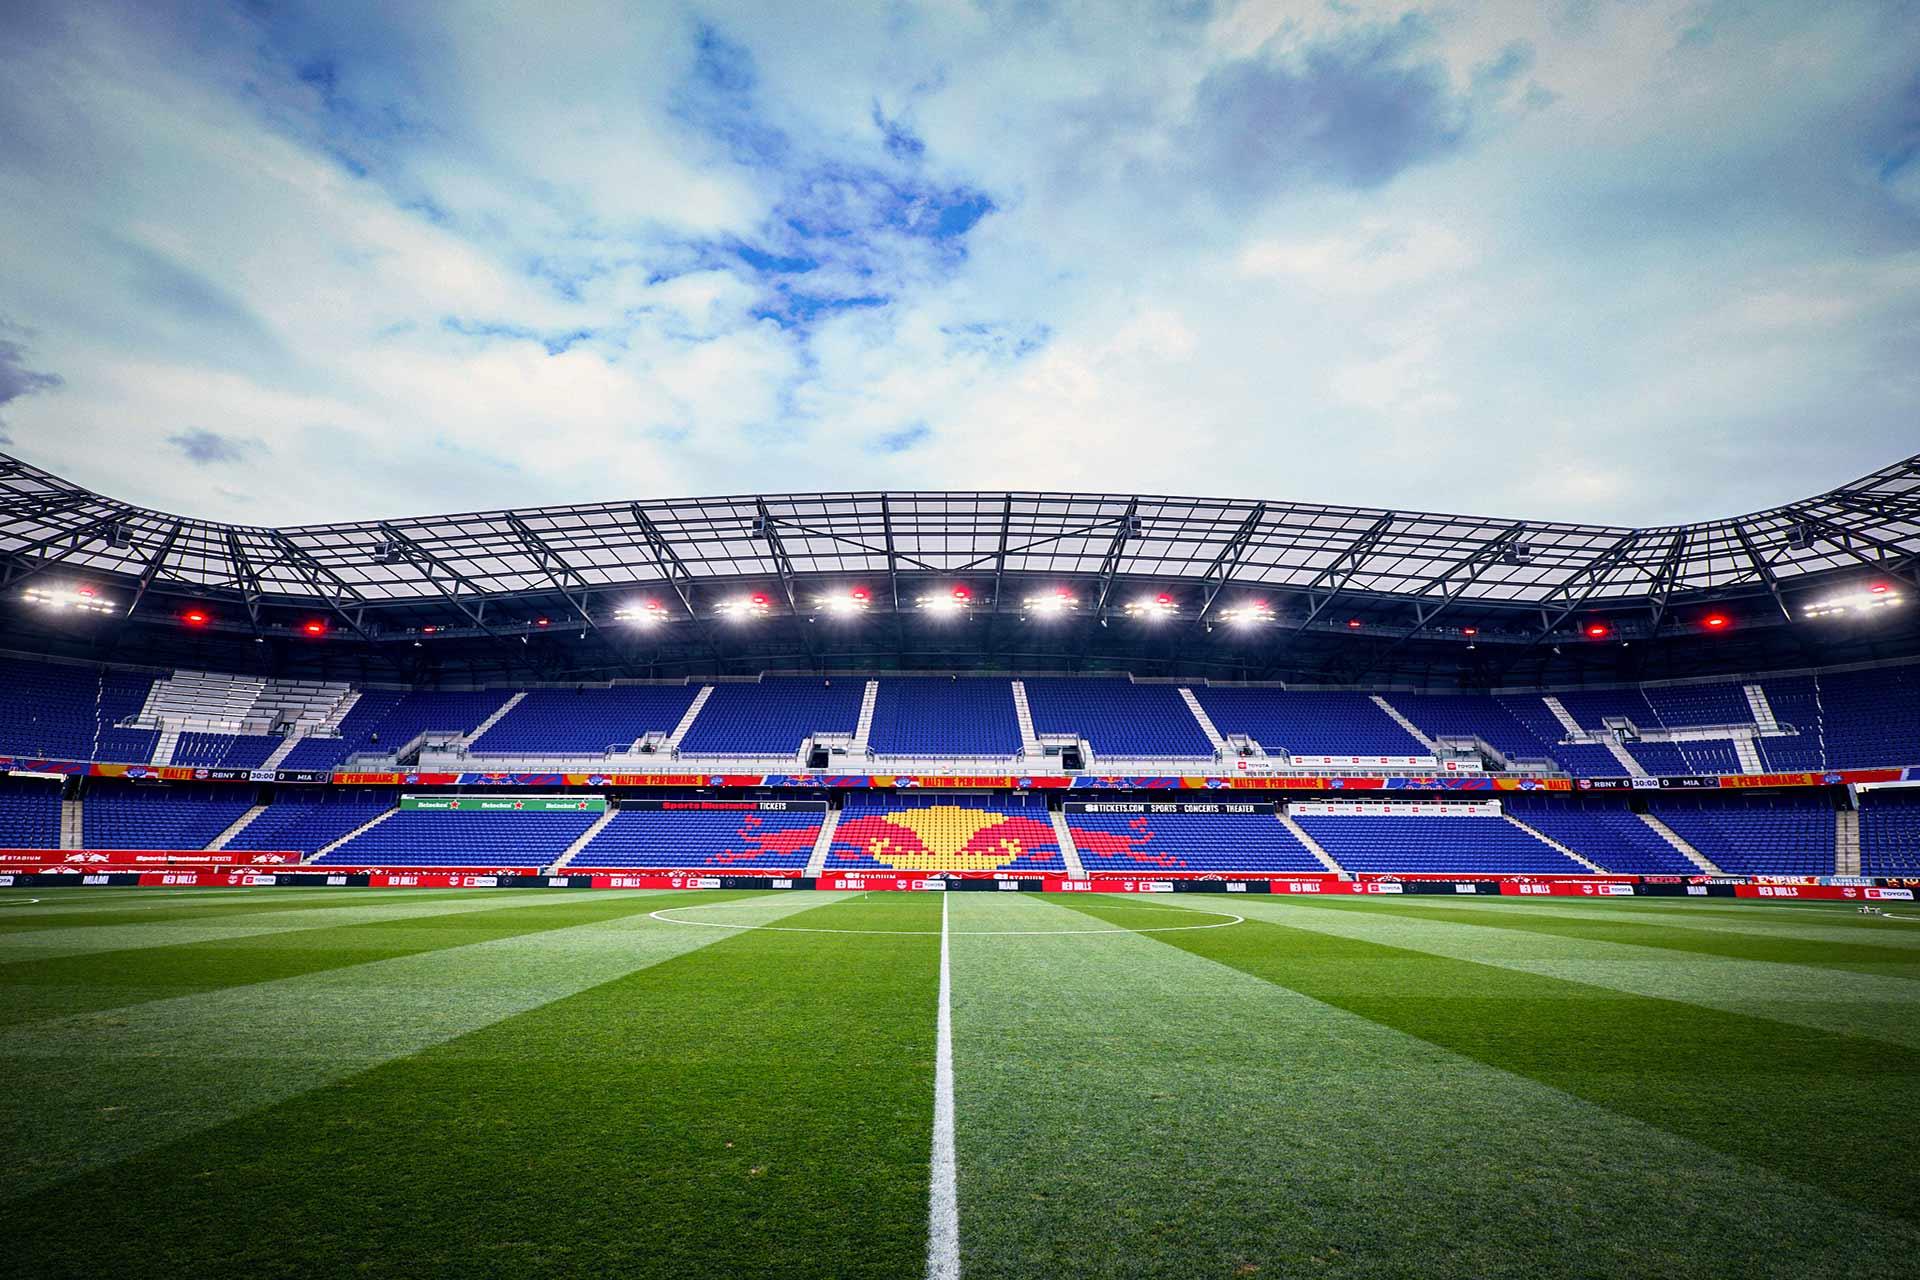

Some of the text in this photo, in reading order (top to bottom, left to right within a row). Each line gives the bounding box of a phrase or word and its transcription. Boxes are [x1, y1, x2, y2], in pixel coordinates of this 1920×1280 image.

[251, 772, 274, 780] 30:00
[347, 773, 394, 783] PERFORMANCE
[651, 775, 698, 785] PERFORMANCE
[1738, 774, 1807, 787] PERFORMANCE
[959, 776, 1006, 787] PERFORMANCE
[1270, 778, 1318, 788] PERFORMANCE
[662, 801, 786, 810] Sports Illustrated TICKETS
[1151, 804, 1177, 813] SPORTS
[1184, 804, 1219, 813] CONCERTS
[1226, 805, 1255, 813] THEATER
[162, 875, 198, 884] RED BULLS
[388, 876, 418, 885] RED BULLS
[610, 878, 640, 887] RED BULLS
[835, 879, 865, 889] RED BULLS
[1757, 876, 1809, 884] EMPIRE
[1061, 881, 1092, 890] RED BULLS
[1290, 883, 1320, 892] RED BULLS
[1519, 884, 1551, 894] RED BULLS
[1758, 886, 1799, 897] RED BULLS
